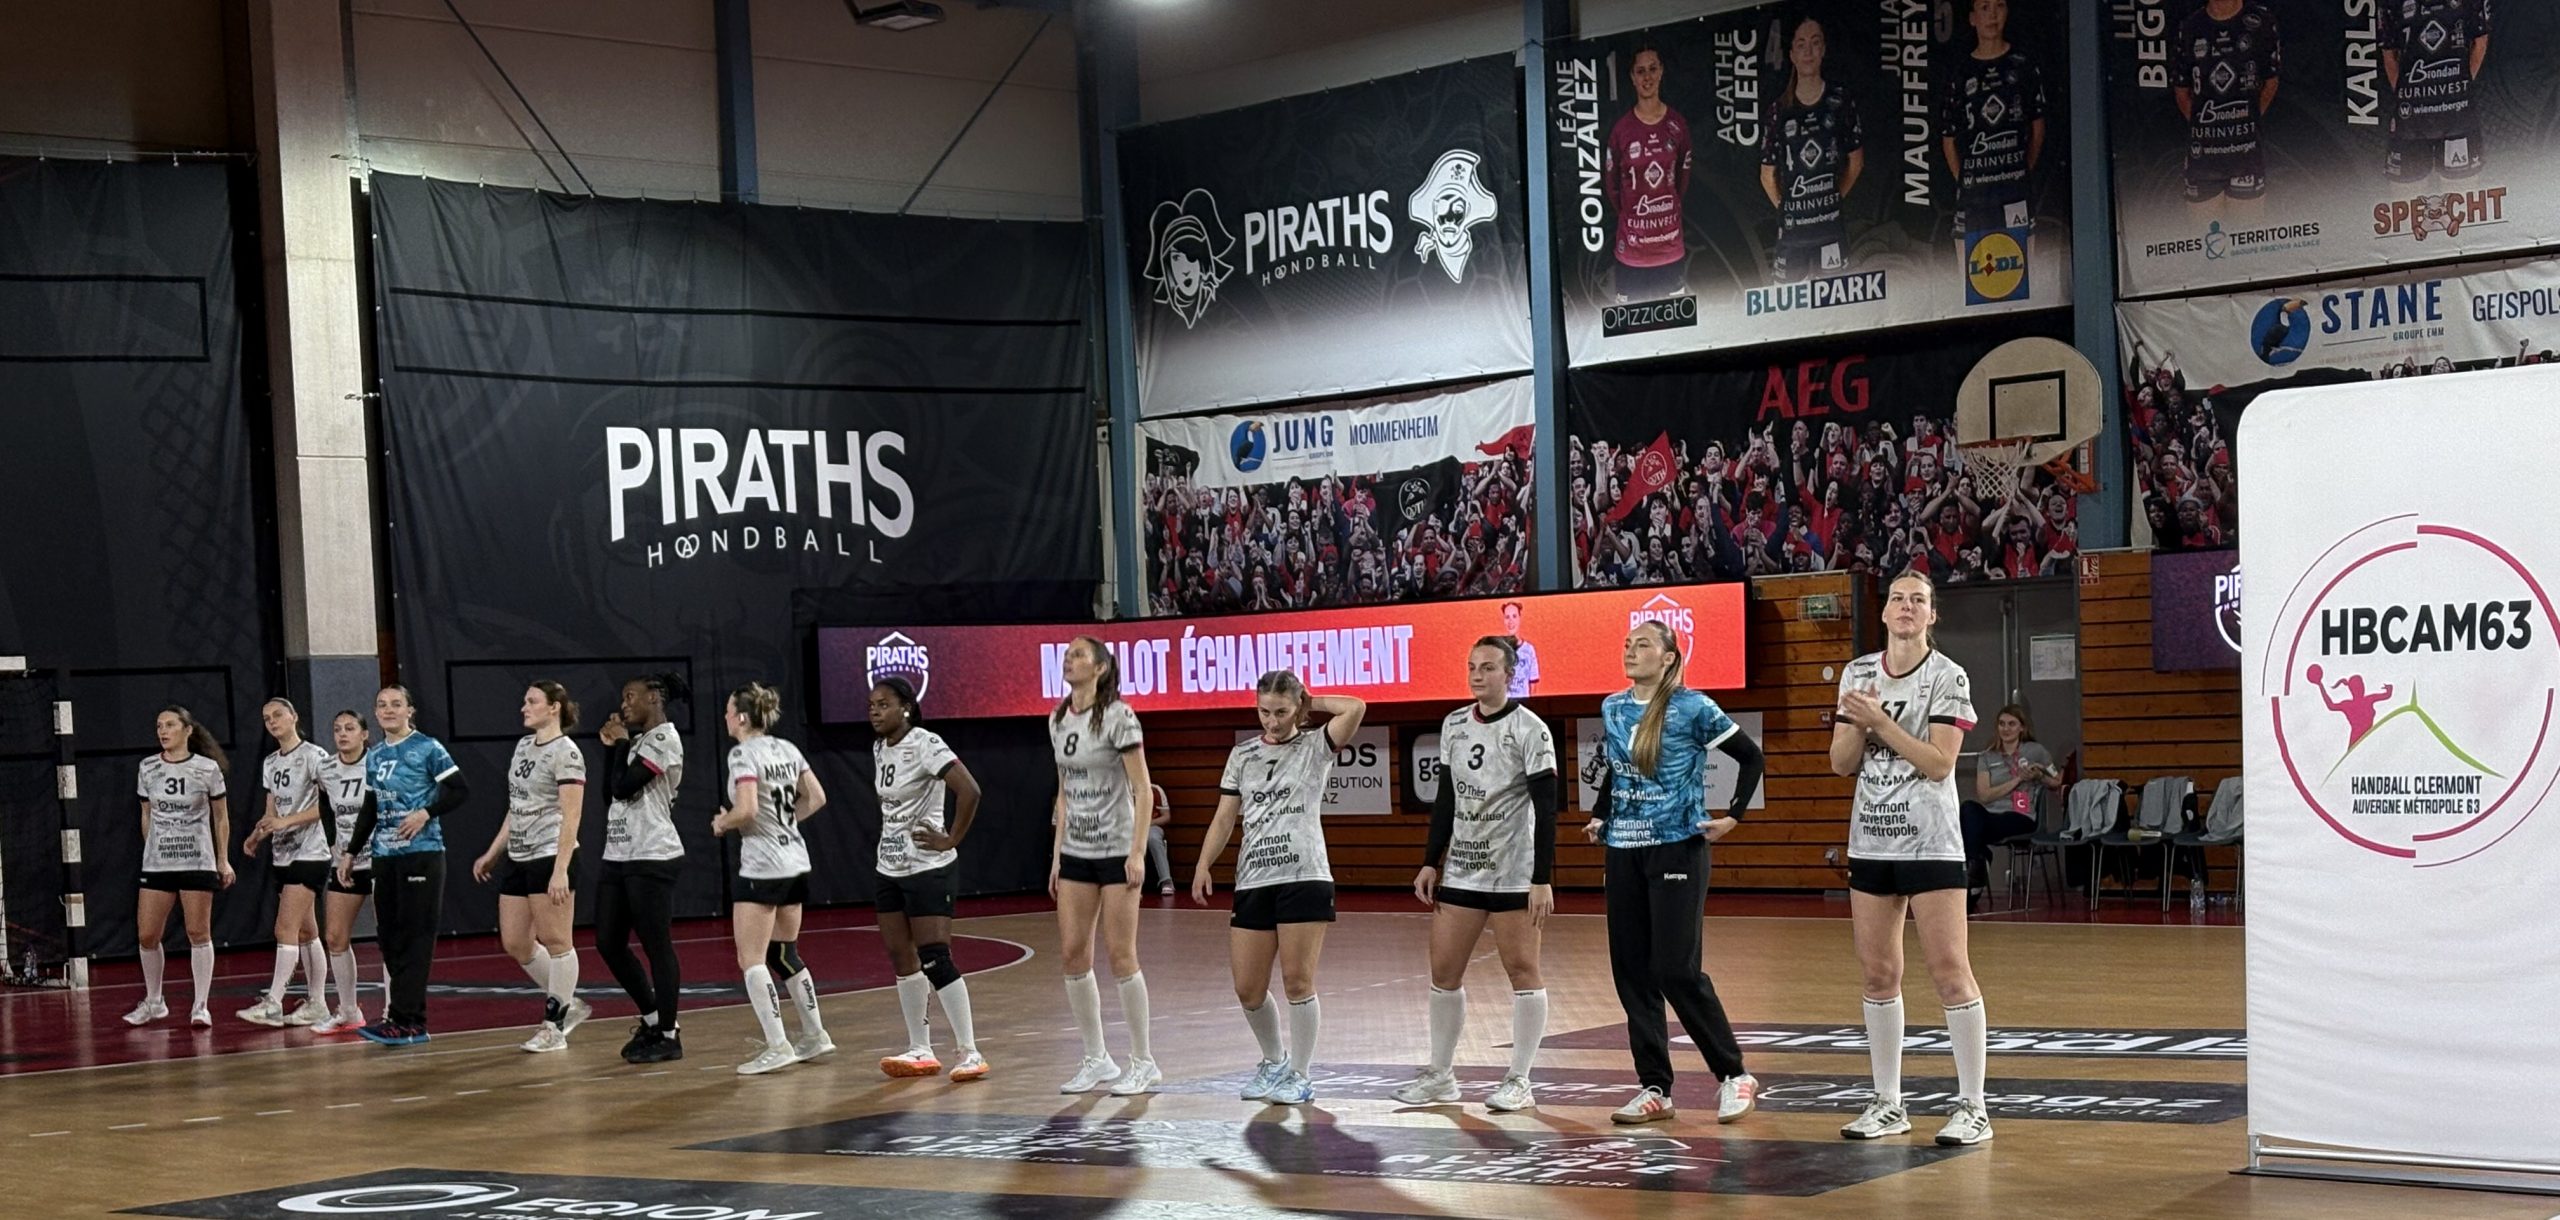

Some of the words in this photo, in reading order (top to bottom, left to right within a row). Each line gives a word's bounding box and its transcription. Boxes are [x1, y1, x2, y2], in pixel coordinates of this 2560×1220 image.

[2405, 58, 2461, 83] Brondani
[1715, 32, 1735, 144] AGATHE
[1733, 29, 1759, 146] CLERC
[2398, 80, 2469, 99] EURINVEST
[1556, 60, 1578, 148] LÉANE
[1902, 0, 1930, 206] MAUFFREY
[2197, 100, 2249, 123] Brondani
[2413, 100, 2468, 115] wienerberger
[1969, 130, 2018, 155] Brondani
[2204, 141, 2256, 155] wienerberger
[1574, 58, 1604, 252] GONZALEZ
[1963, 151, 2025, 169] EURINVEST
[1629, 167, 1636, 190] 1
[1789, 174, 1834, 197] Brondani
[1975, 169, 2026, 184] wienerberger
[1784, 193, 1840, 211] EURINVEST
[2373, 186, 2508, 235] SPECHT
[1796, 210, 1840, 226] wienerberger
[1244, 189, 1394, 275] PIRATHS
[2146, 238, 2203, 257] PIERRES
[2229, 222, 2320, 246] TERRITOIRES
[2321, 280, 2443, 335] STANE
[2393, 328, 2424, 341] GROUPE
[1756, 354, 1870, 421] AEG
[1273, 415, 1334, 453] JUNG
[1350, 415, 1439, 446] MOMMENHEIM
[605, 426, 915, 542] PIRATHS
[1630, 608, 1694, 634] PIRATHS
[2321, 600, 2532, 655] HBCAM63
[867, 646, 929, 670] PIRATHS
[1180, 624, 1414, 694] ÉCHAUFFEMENT
[1064, 733, 1079, 756] 8
[1468, 743, 1485, 770] 3
[273, 768, 291, 789] 95
[376, 760, 397, 782] 57
[515, 759, 536, 779] 38
[764, 762, 797, 781] MARTY
[880, 764, 896, 788] 18
[1265, 759, 1278, 781] 7
[165, 777, 185, 795] 31
[340, 778, 362, 798] 77
[2351, 776, 2411, 795] HANDBALL
[2414, 775, 2482, 794] CLERMONT
[1863, 800, 1911, 813] clermont
[2352, 799, 2402, 815] AUVERGNE
[2404, 795, 2464, 814] MÉTROPOLE
[2466, 799, 2480, 814] 63
[1859, 812, 1907, 825] auvergne
[1863, 824, 1919, 839] métropole
[1250, 852, 1300, 870] métropole
[1668, 1031, 2174, 1051] Grand
[1916, 1029, 2135, 1039] Rgion
[1311, 1075, 1643, 1093] Buagaz
[886, 1136, 1142, 1152] ALSACE
[909, 1143, 1067, 1155] LAIT
[1380, 1154, 1699, 1175] ALSACE
[1412, 1164, 1592, 1178] LAIT
[1484, 1176, 1631, 1187] TRADITION
[491, 1197, 823, 1220] EQIOM
